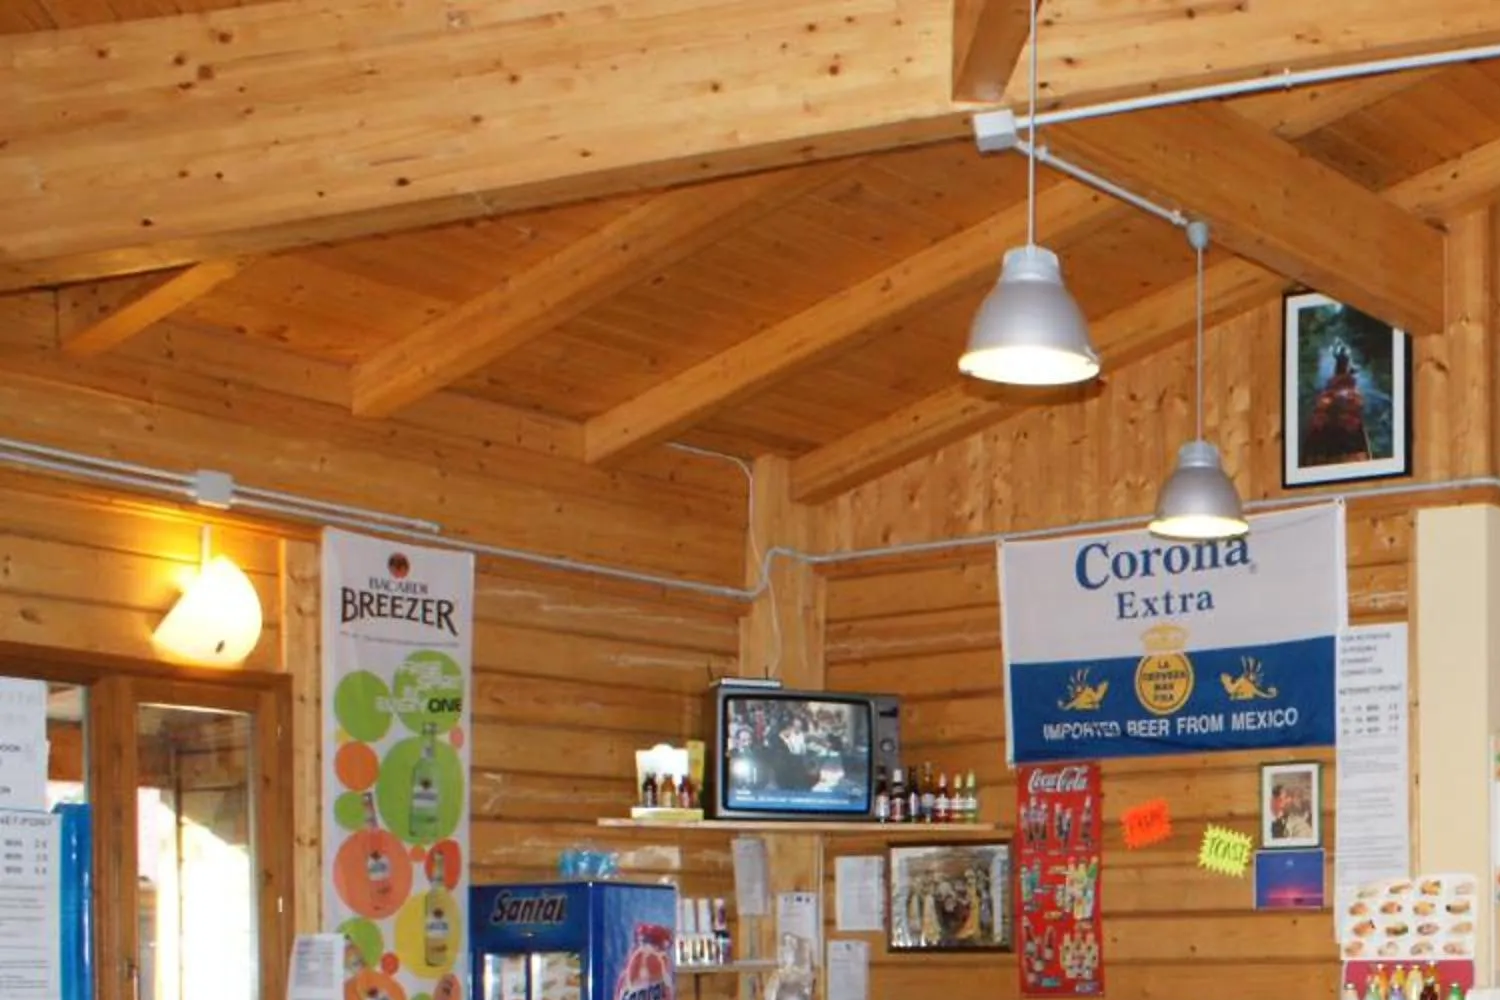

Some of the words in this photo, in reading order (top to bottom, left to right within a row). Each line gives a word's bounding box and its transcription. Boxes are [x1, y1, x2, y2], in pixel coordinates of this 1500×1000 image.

[1075, 535, 1250, 590] Corona
[341, 587, 458, 636] BREEZER
[1116, 589, 1214, 620] Extra
[1043, 721, 1121, 741] IMPORTED
[1127, 717, 1170, 738] BEER
[1177, 713, 1223, 735] FROM
[1231, 707, 1298, 730] MEXICO
[490, 888, 568, 925] Santal
